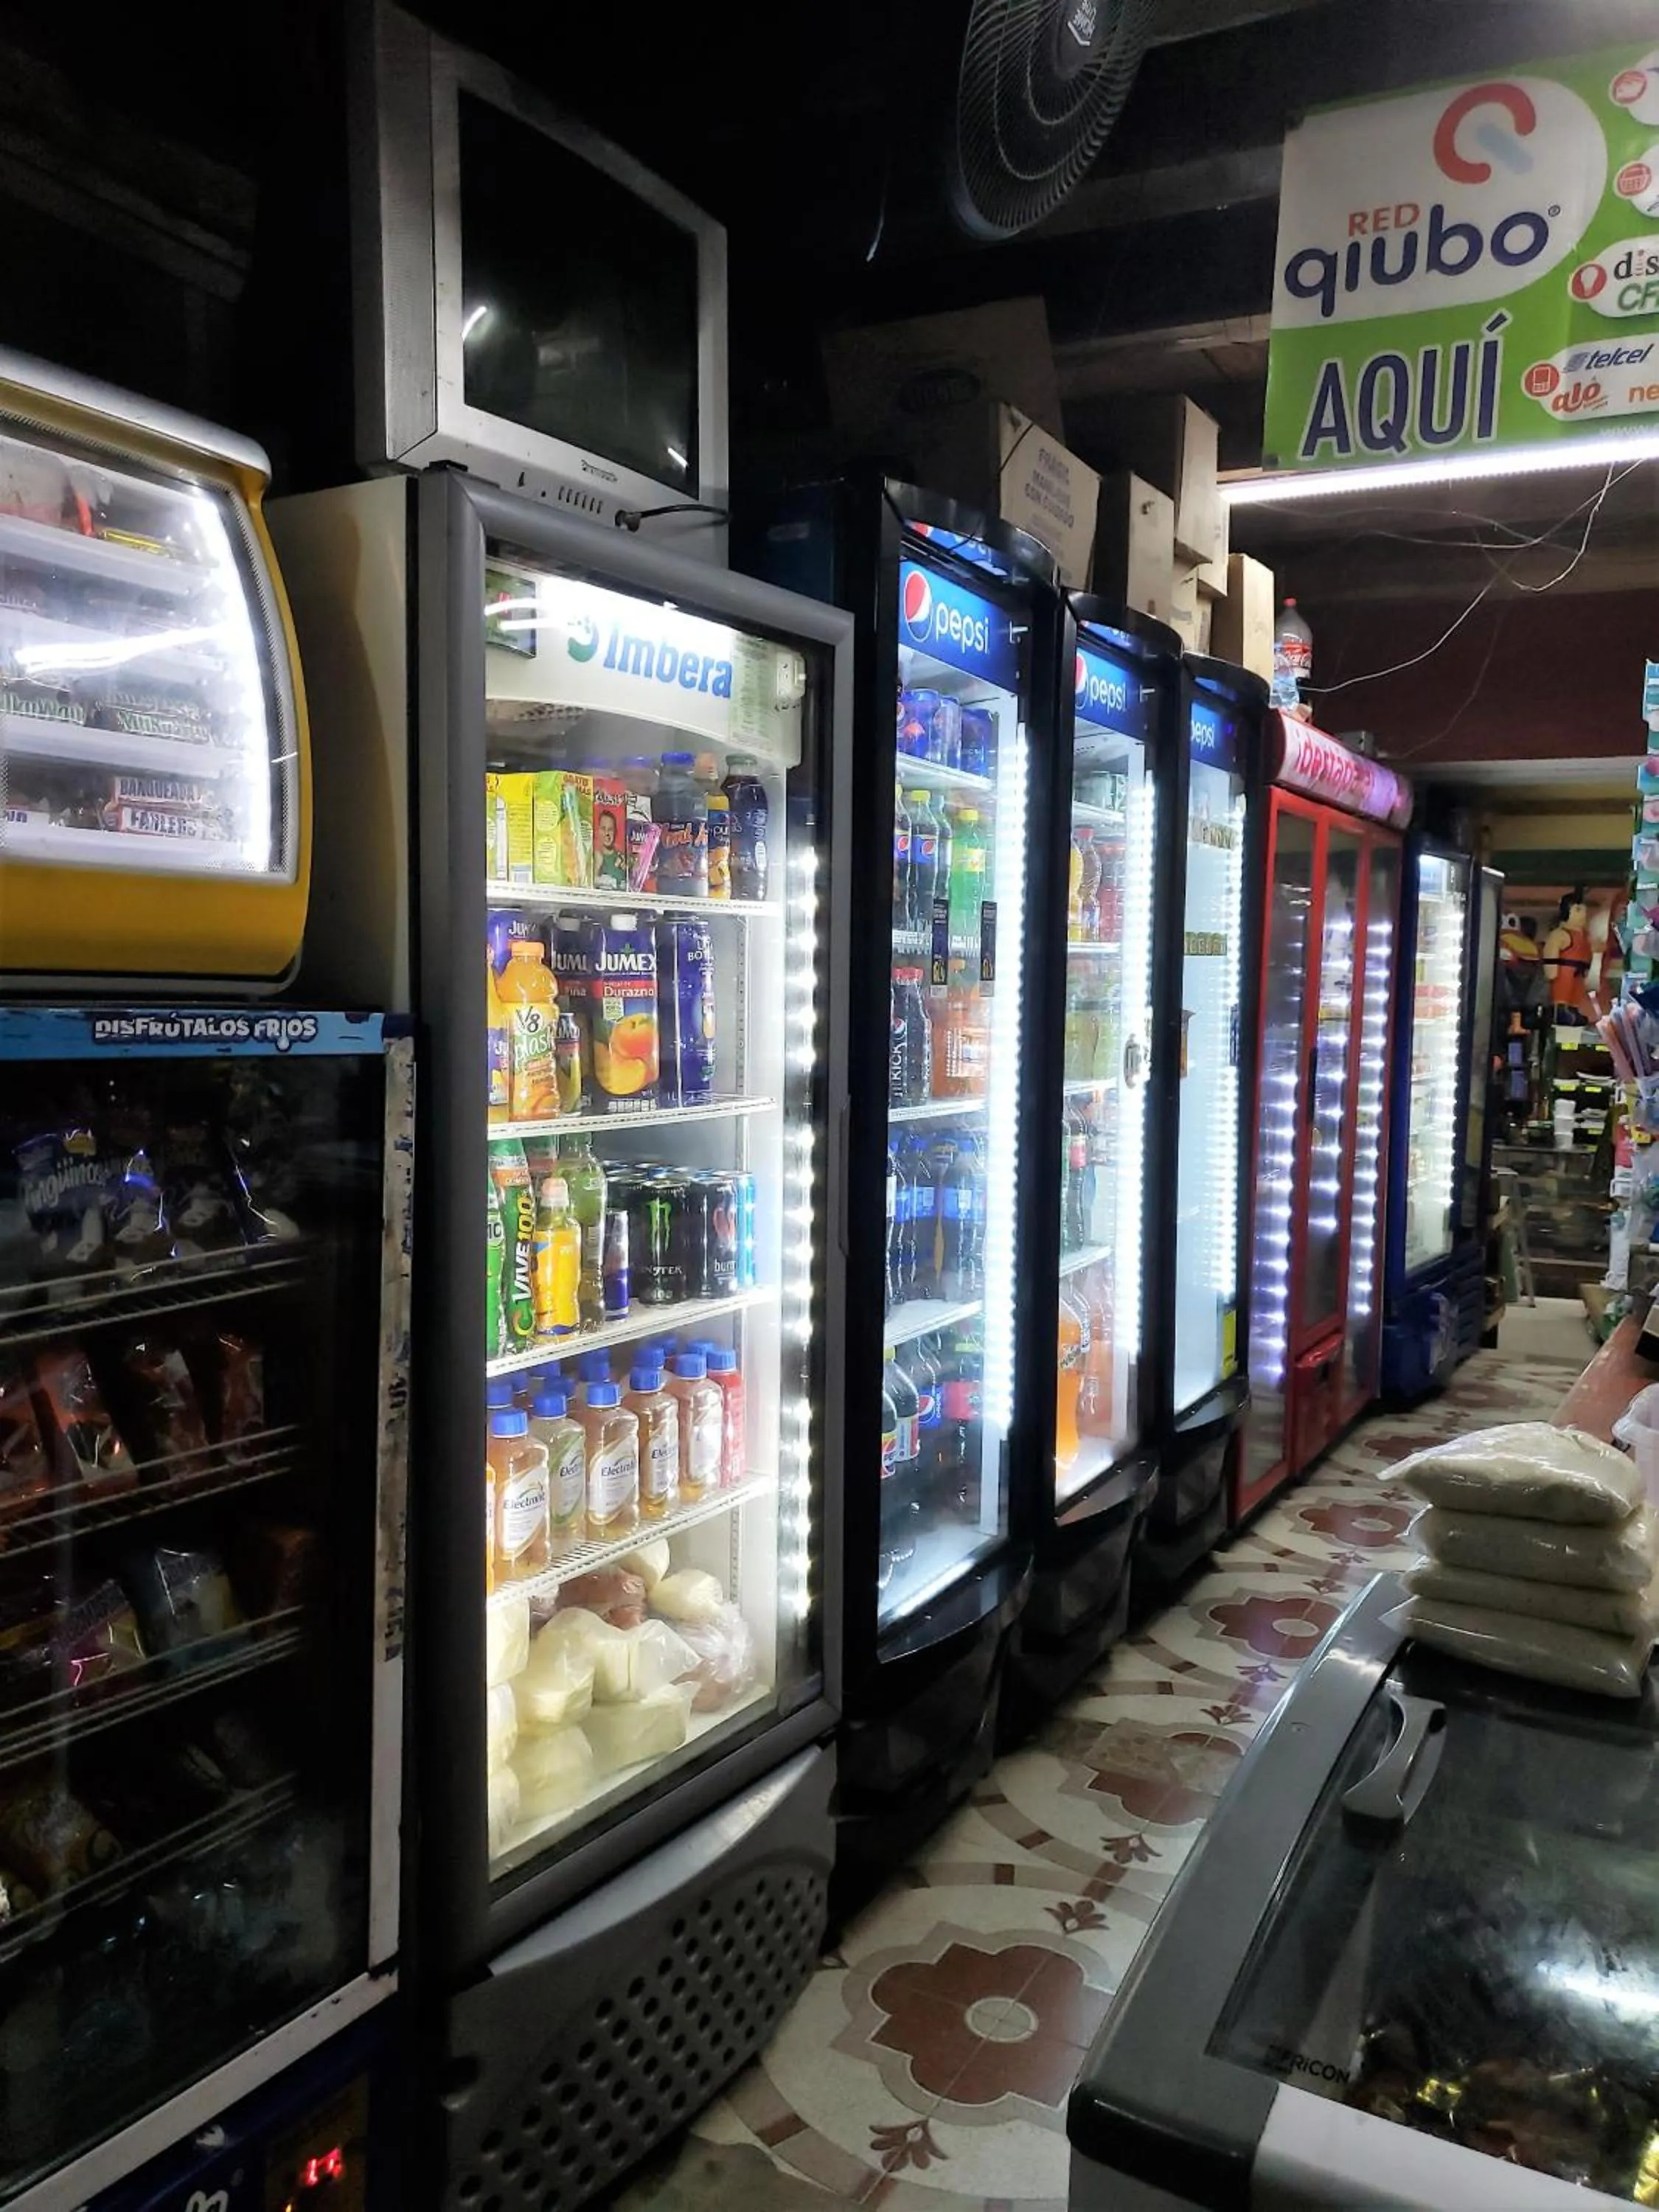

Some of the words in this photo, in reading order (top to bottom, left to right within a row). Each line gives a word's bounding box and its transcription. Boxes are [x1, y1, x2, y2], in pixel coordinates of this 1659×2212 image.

[1348, 203, 1420, 237] RED
[1284, 204, 1549, 318] qiubo
[1585, 343, 1655, 370] telcel
[1300, 312, 1509, 458] AQUÍ
[935, 602, 990, 655] pepsi
[1089, 674, 1128, 714] pepsi
[595, 952, 658, 973] JUMEX
[603, 986, 655, 998] Durazno
[95, 1012, 250, 1039] DISFRÚTALOS
